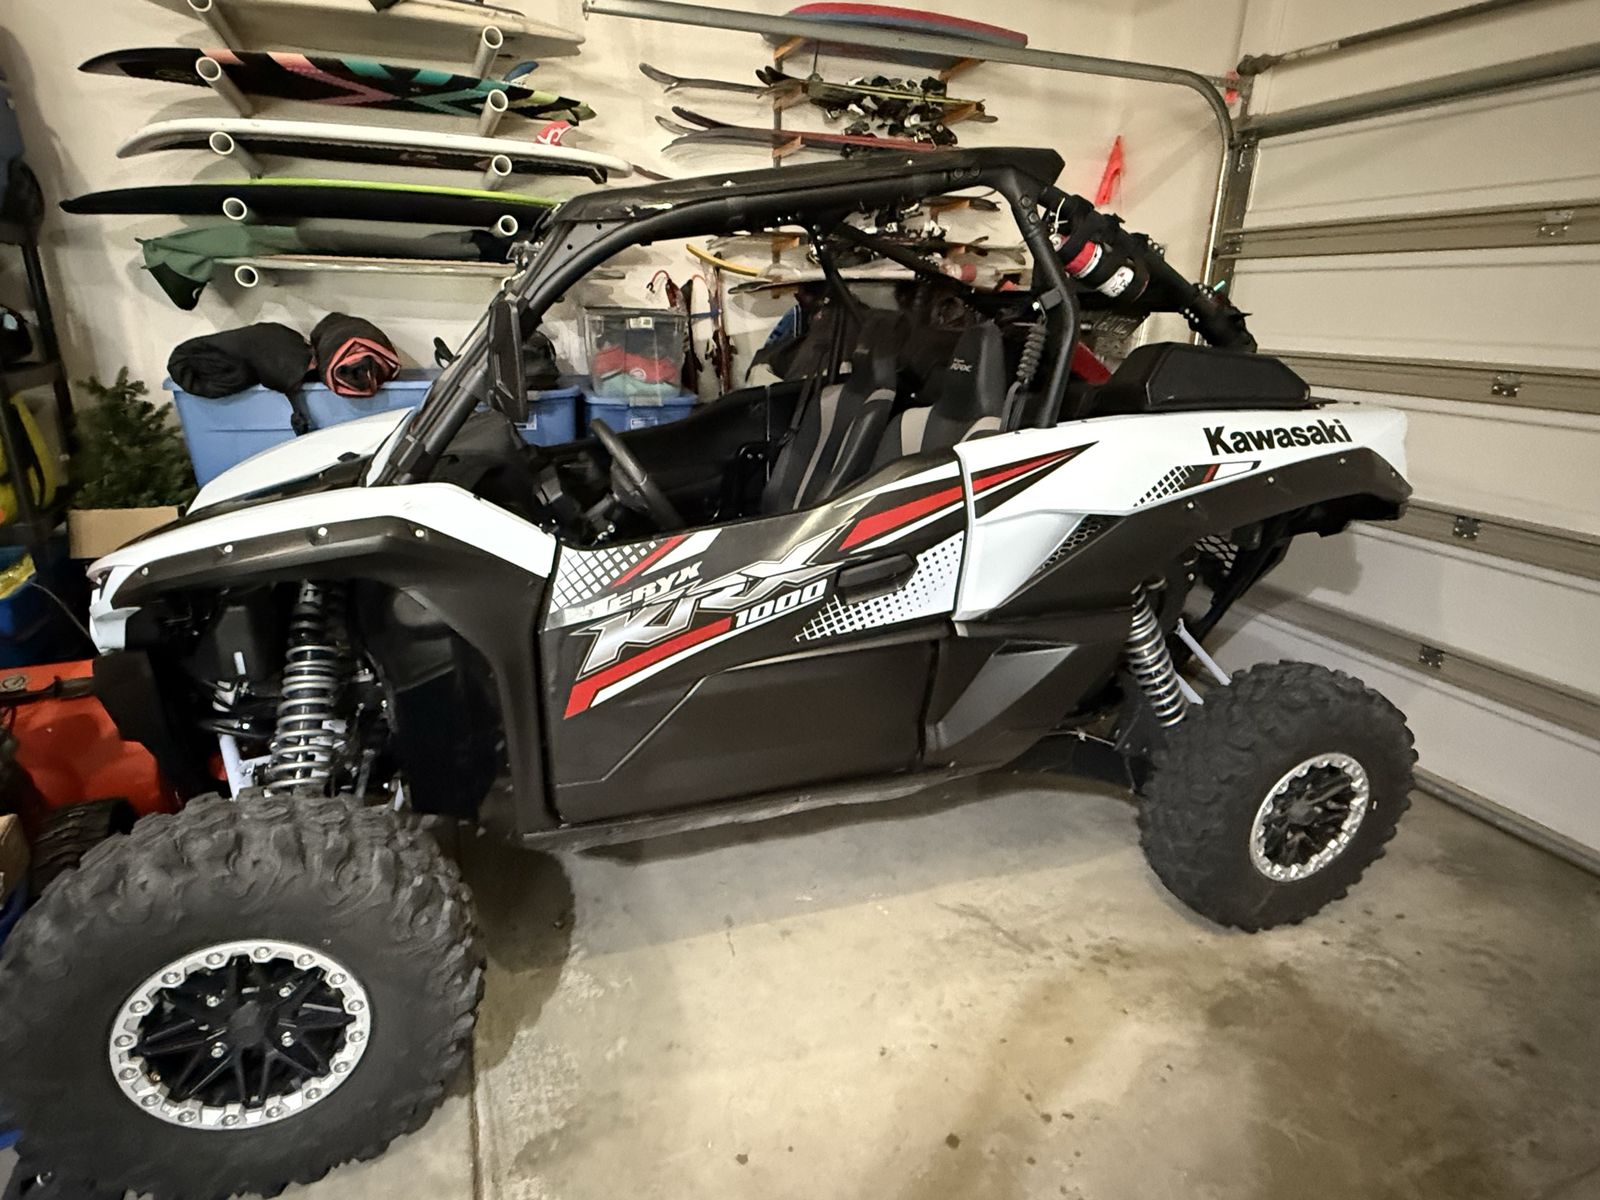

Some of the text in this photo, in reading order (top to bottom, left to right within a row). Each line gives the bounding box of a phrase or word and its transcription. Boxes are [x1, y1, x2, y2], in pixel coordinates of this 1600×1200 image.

[1203, 419, 1353, 456] Kawasaki
[570, 519, 854, 680] KRX
[584, 561, 703, 614] TERYX
[735, 579, 828, 628] 1000
